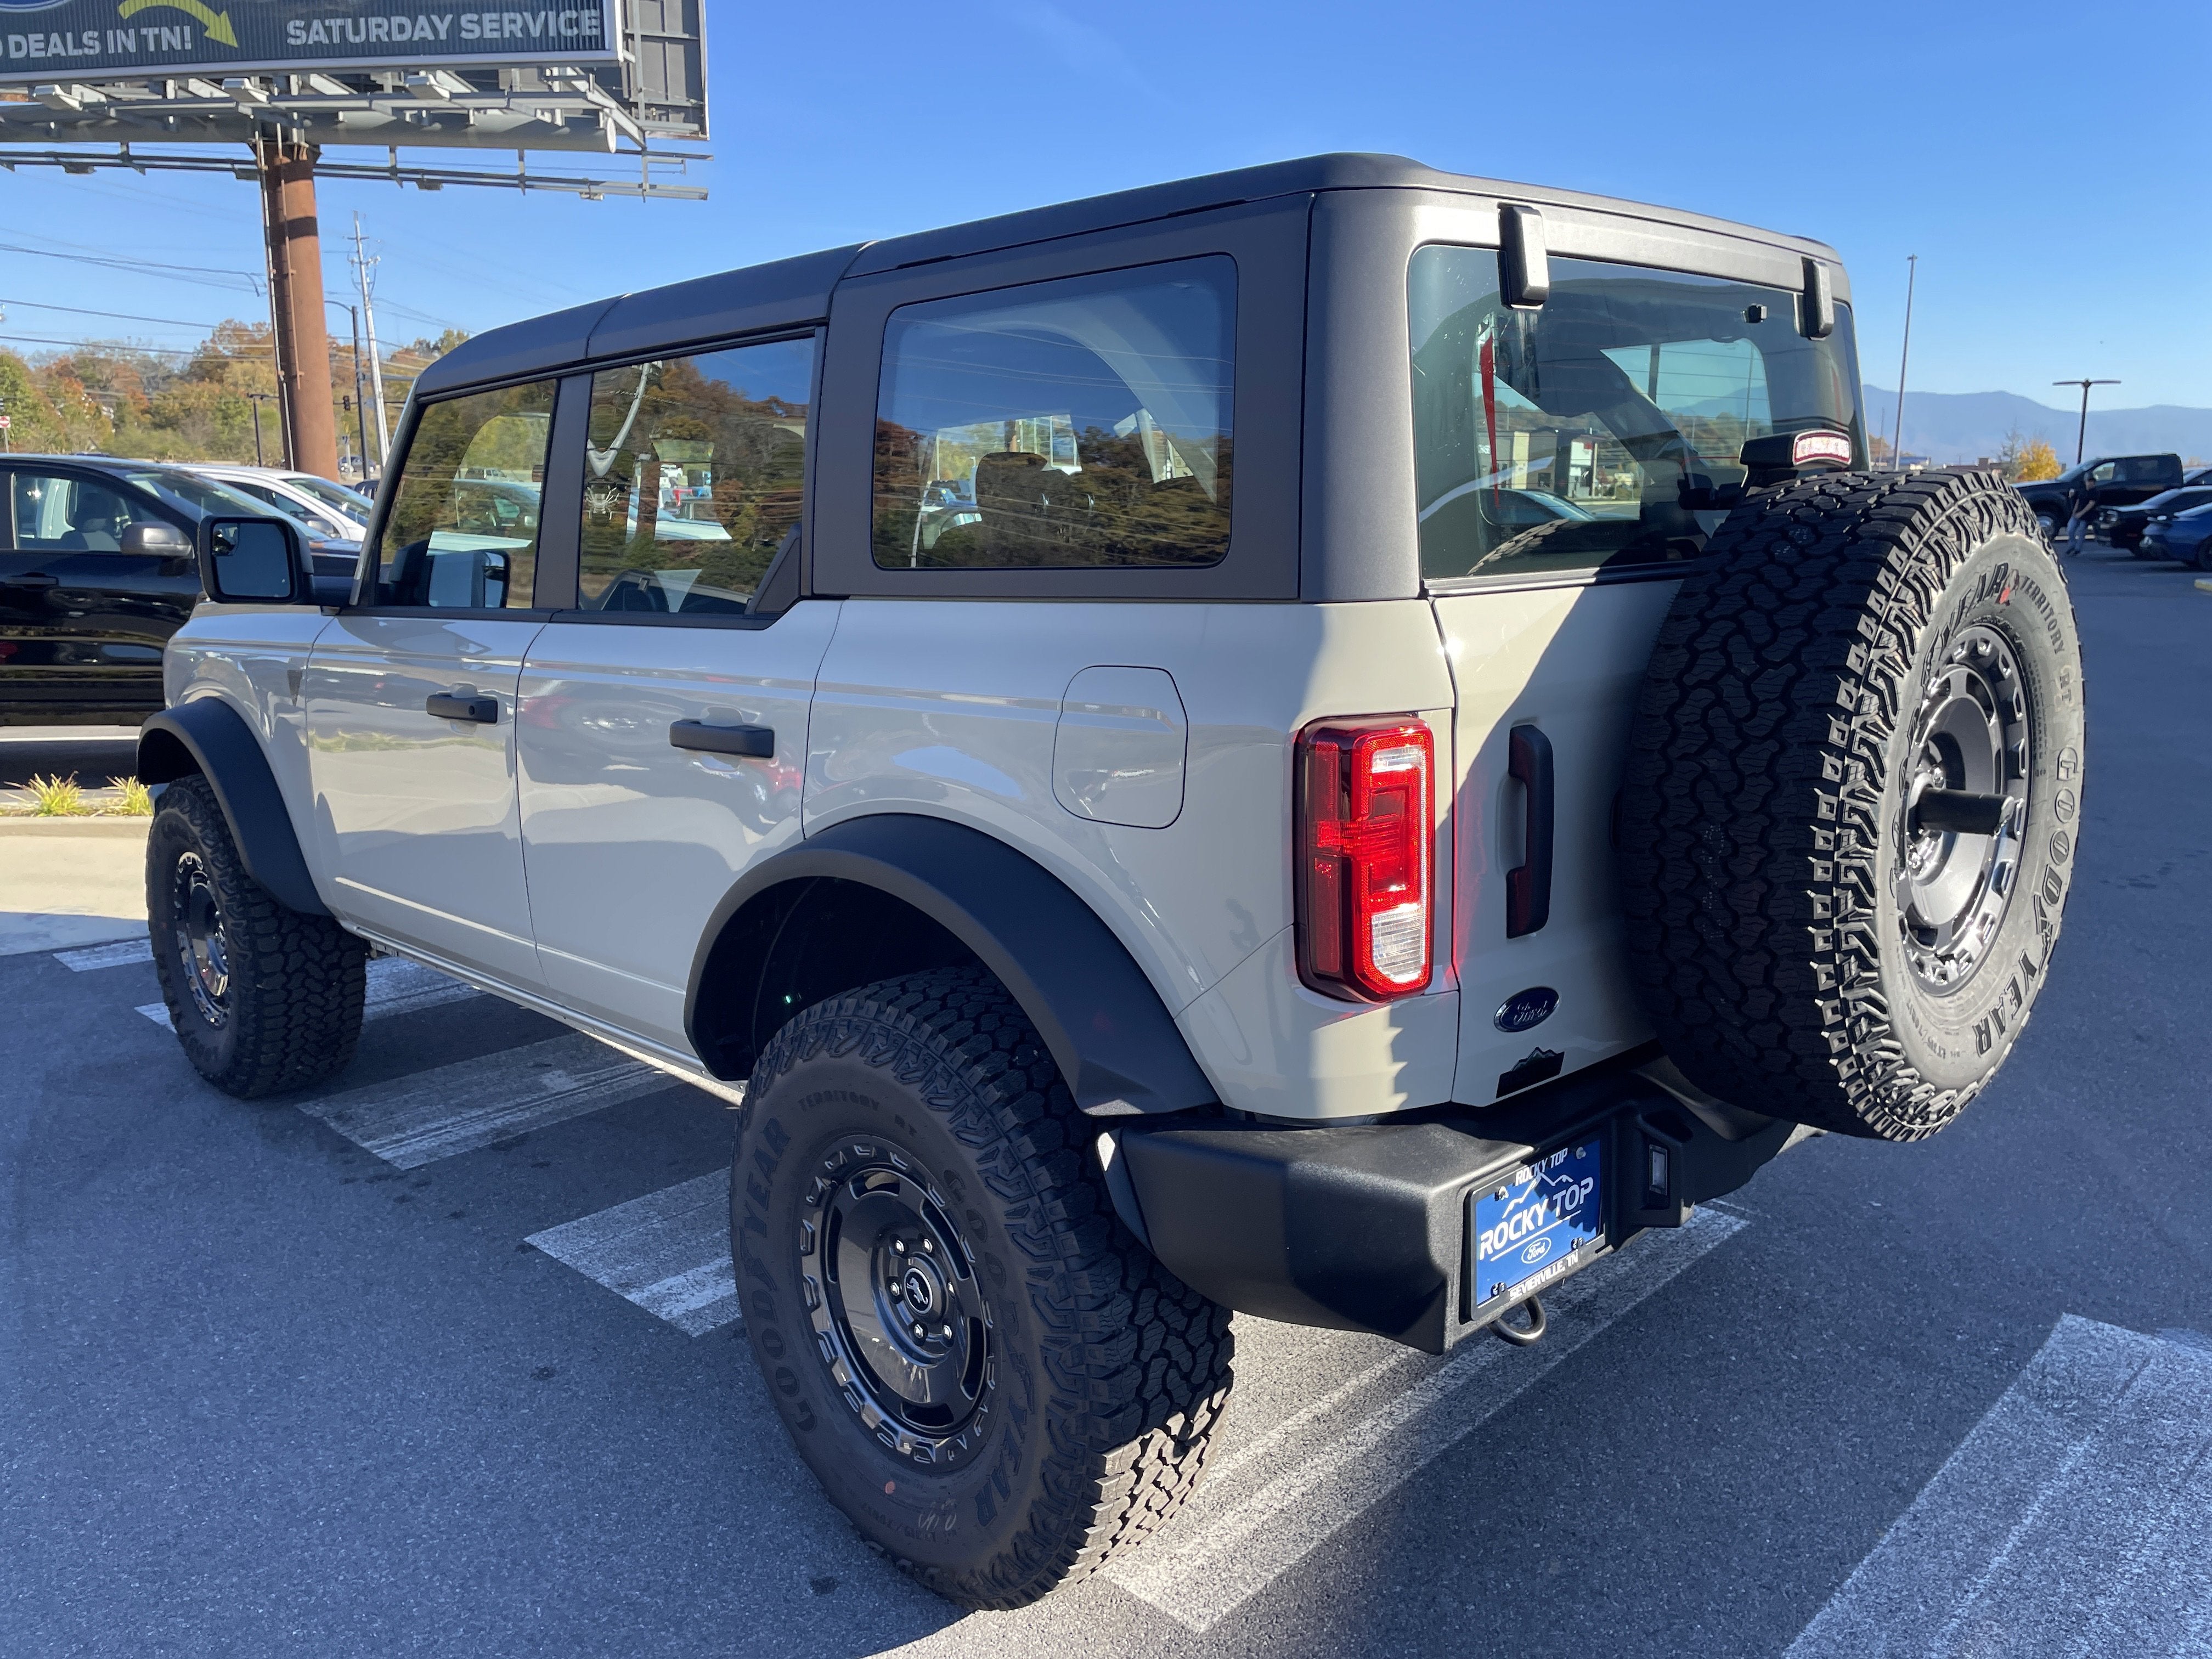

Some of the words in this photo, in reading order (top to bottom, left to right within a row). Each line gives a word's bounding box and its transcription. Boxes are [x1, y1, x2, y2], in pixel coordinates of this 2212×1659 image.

[8, 30, 102, 59] DEALS
[106, 29, 137, 54] IN
[140, 25, 191, 52] TN!
[287, 14, 453, 46] SATURDAY
[460, 9, 601, 39] SERVICE
[2020, 575, 2064, 654] TERRITORY
[2059, 673, 2072, 702] RT
[798, 1090, 880, 1112] TERRITORY
[1515, 1158, 1548, 1186] ROCKY
[1550, 1148, 1568, 1170] TOP
[1479, 1198, 1549, 1260] ROCKY
[1553, 1177, 1594, 1218] TOP
[1527, 1239, 1545, 1260] Ford
[1509, 1261, 1566, 1301] SEVIERVILLE,
[1567, 1252, 1578, 1268] TN
